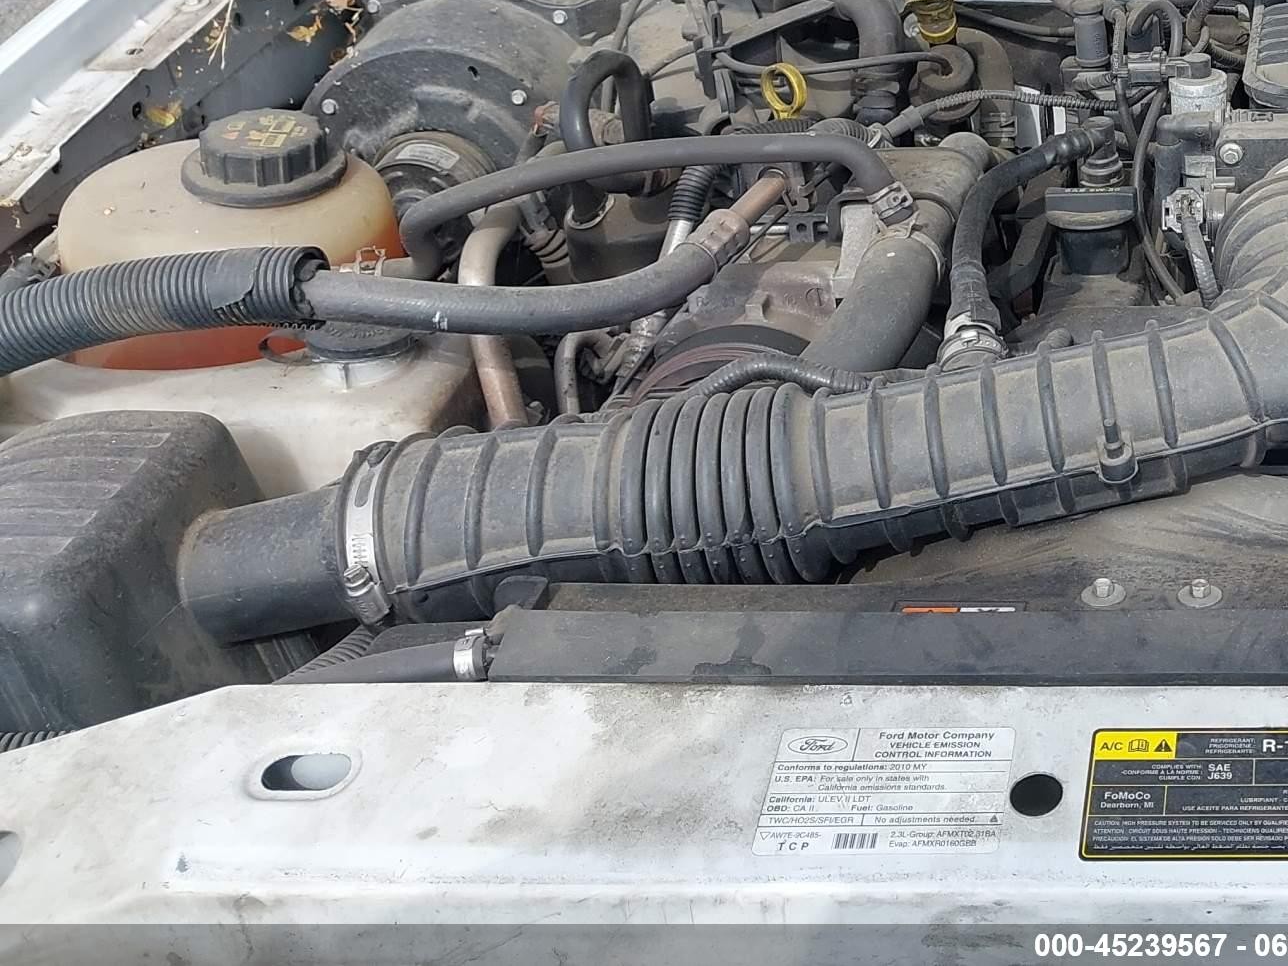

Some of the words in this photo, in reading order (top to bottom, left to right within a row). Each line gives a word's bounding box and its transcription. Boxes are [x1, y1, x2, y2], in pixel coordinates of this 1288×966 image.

[880, 731, 904, 740] Ford
[907, 731, 940, 740] Motor
[942, 731, 995, 740] Company
[800, 739, 835, 752] Ford
[1100, 742, 1124, 751] A/C
[1208, 764, 1231, 772] SAE
[1207, 772, 1233, 780] J639
[1104, 792, 1151, 800] FoMoCo
[777, 842, 785, 851] T
[788, 842, 797, 851] C
[800, 842, 809, 851] P
